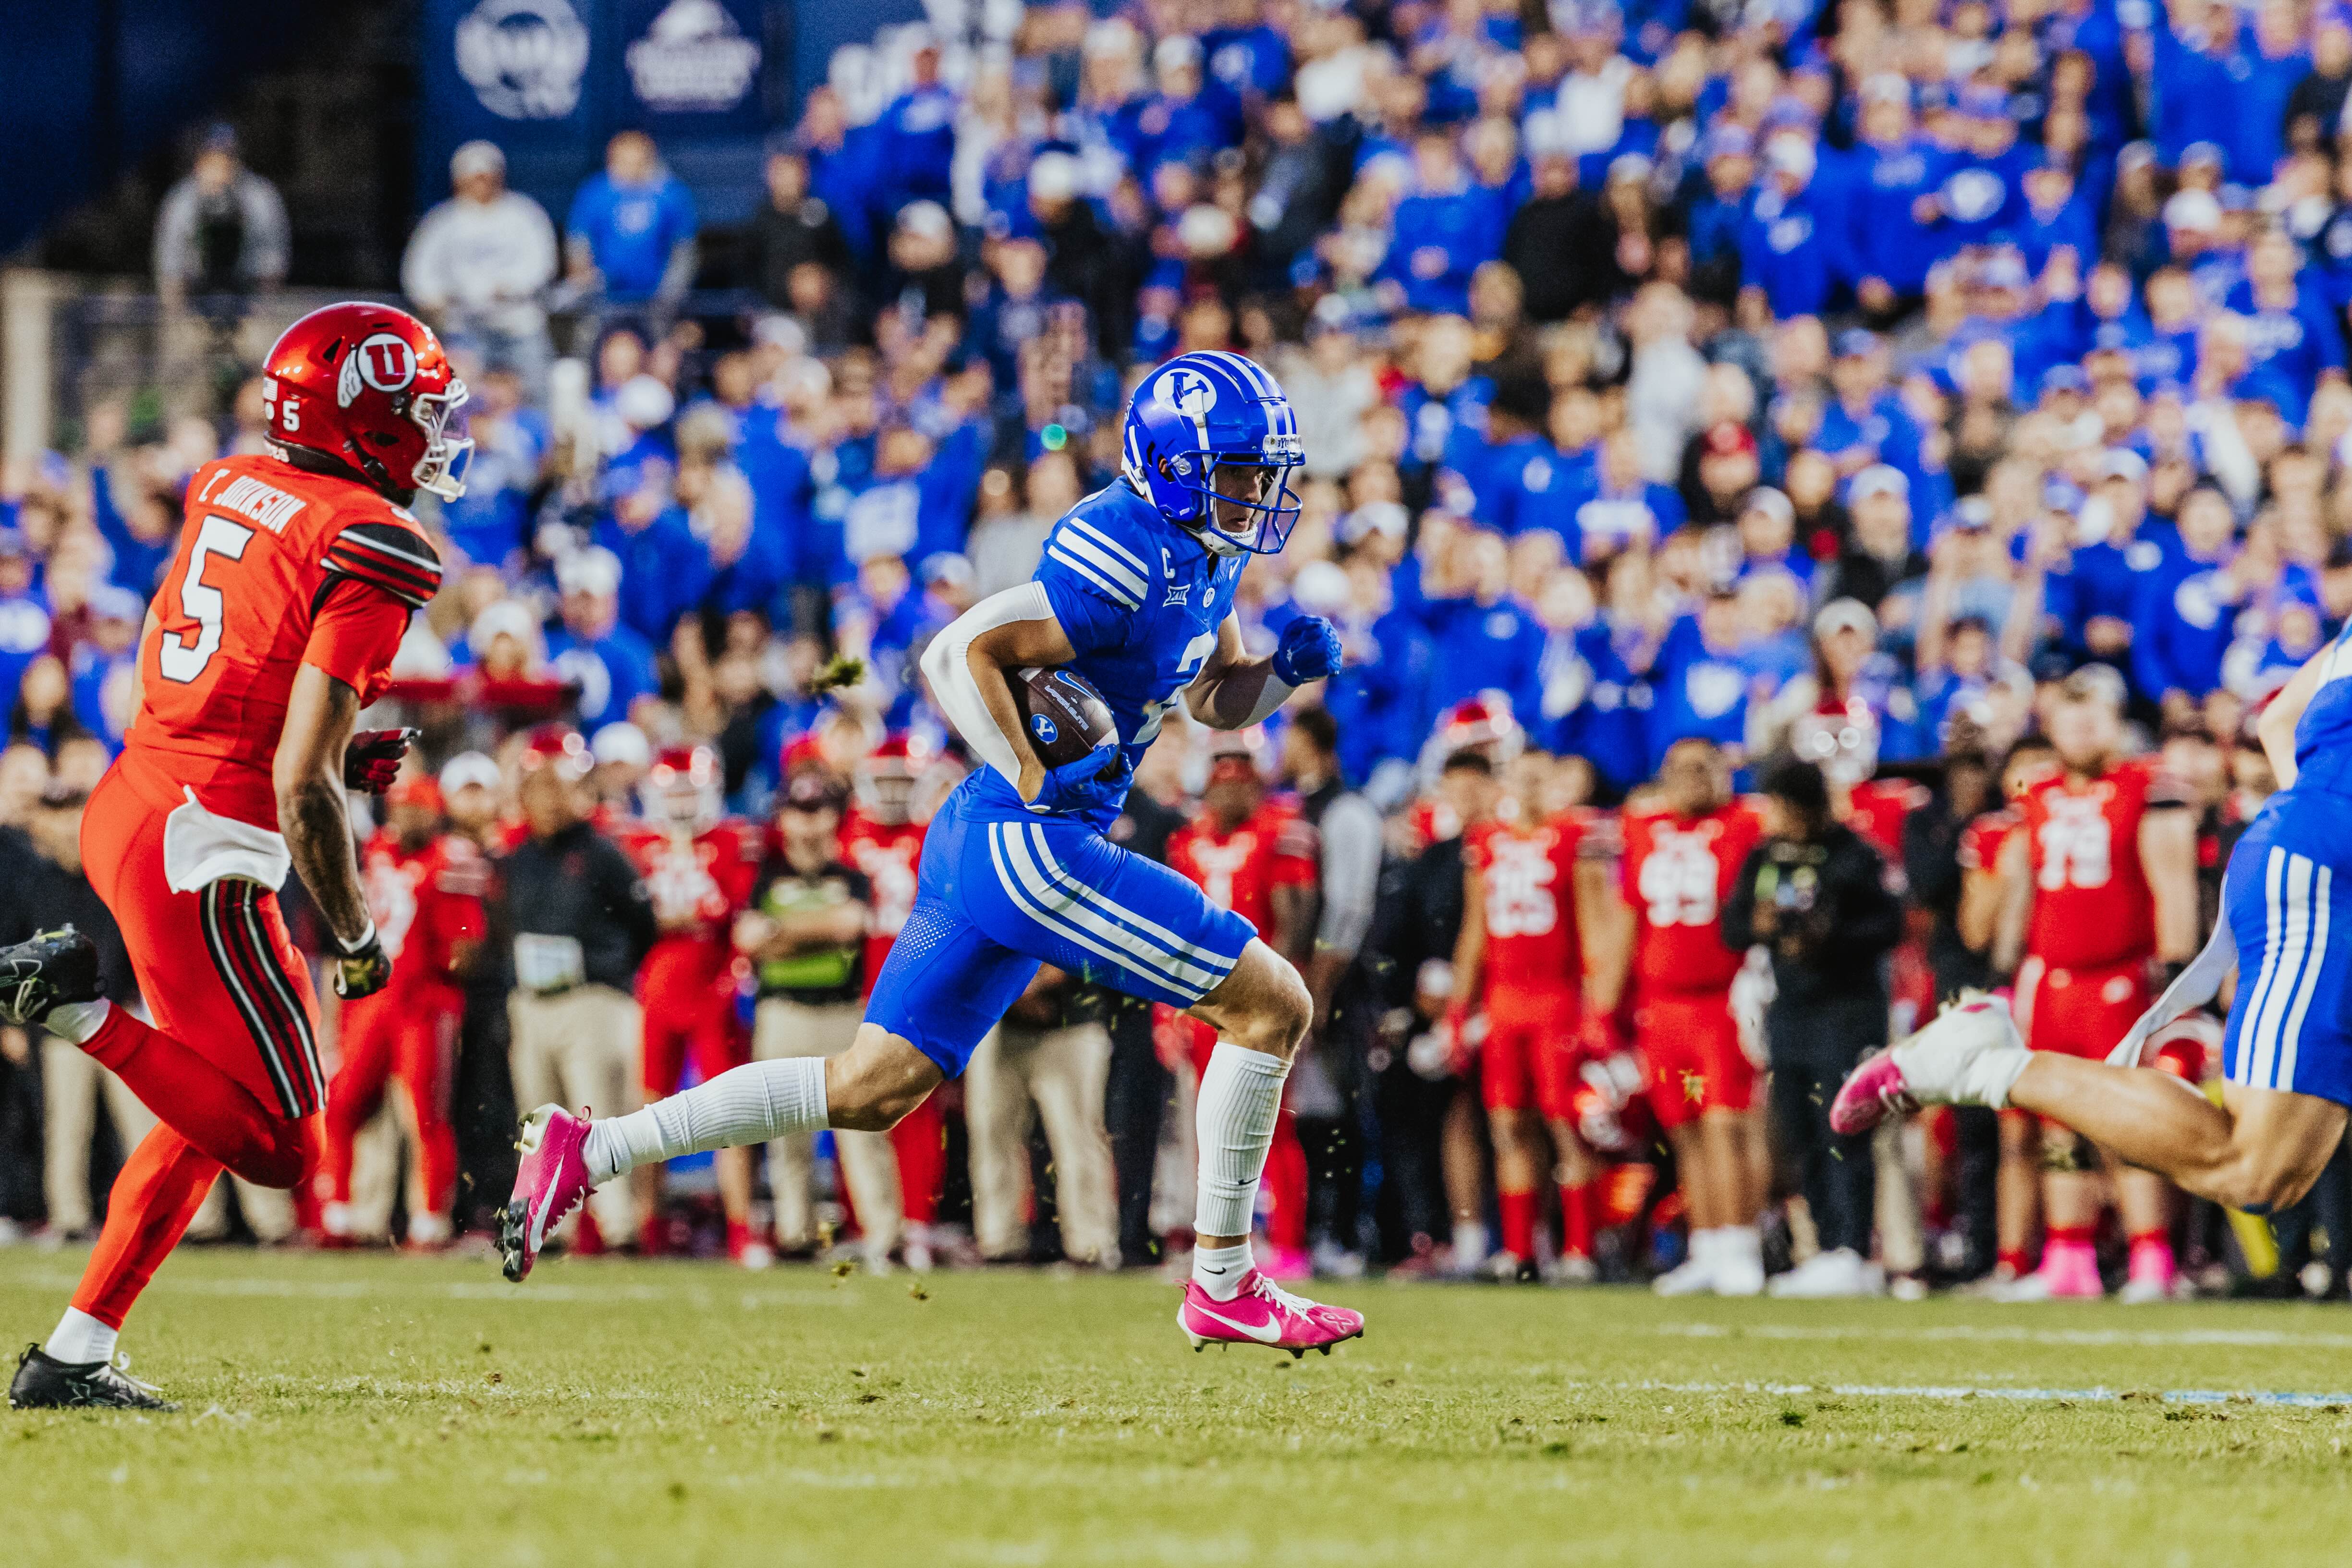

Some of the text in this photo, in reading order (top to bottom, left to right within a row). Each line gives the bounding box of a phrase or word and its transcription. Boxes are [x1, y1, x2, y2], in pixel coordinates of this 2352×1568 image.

[365, 343, 406, 386] U
[282, 400, 300, 431] 5
[213, 475, 307, 535] JOHNSON
[1161, 547, 1176, 579] C
[159, 513, 257, 684] 5
[1036, 717, 1054, 737] Y
[1045, 685, 1089, 730] VAPOR ELITE
